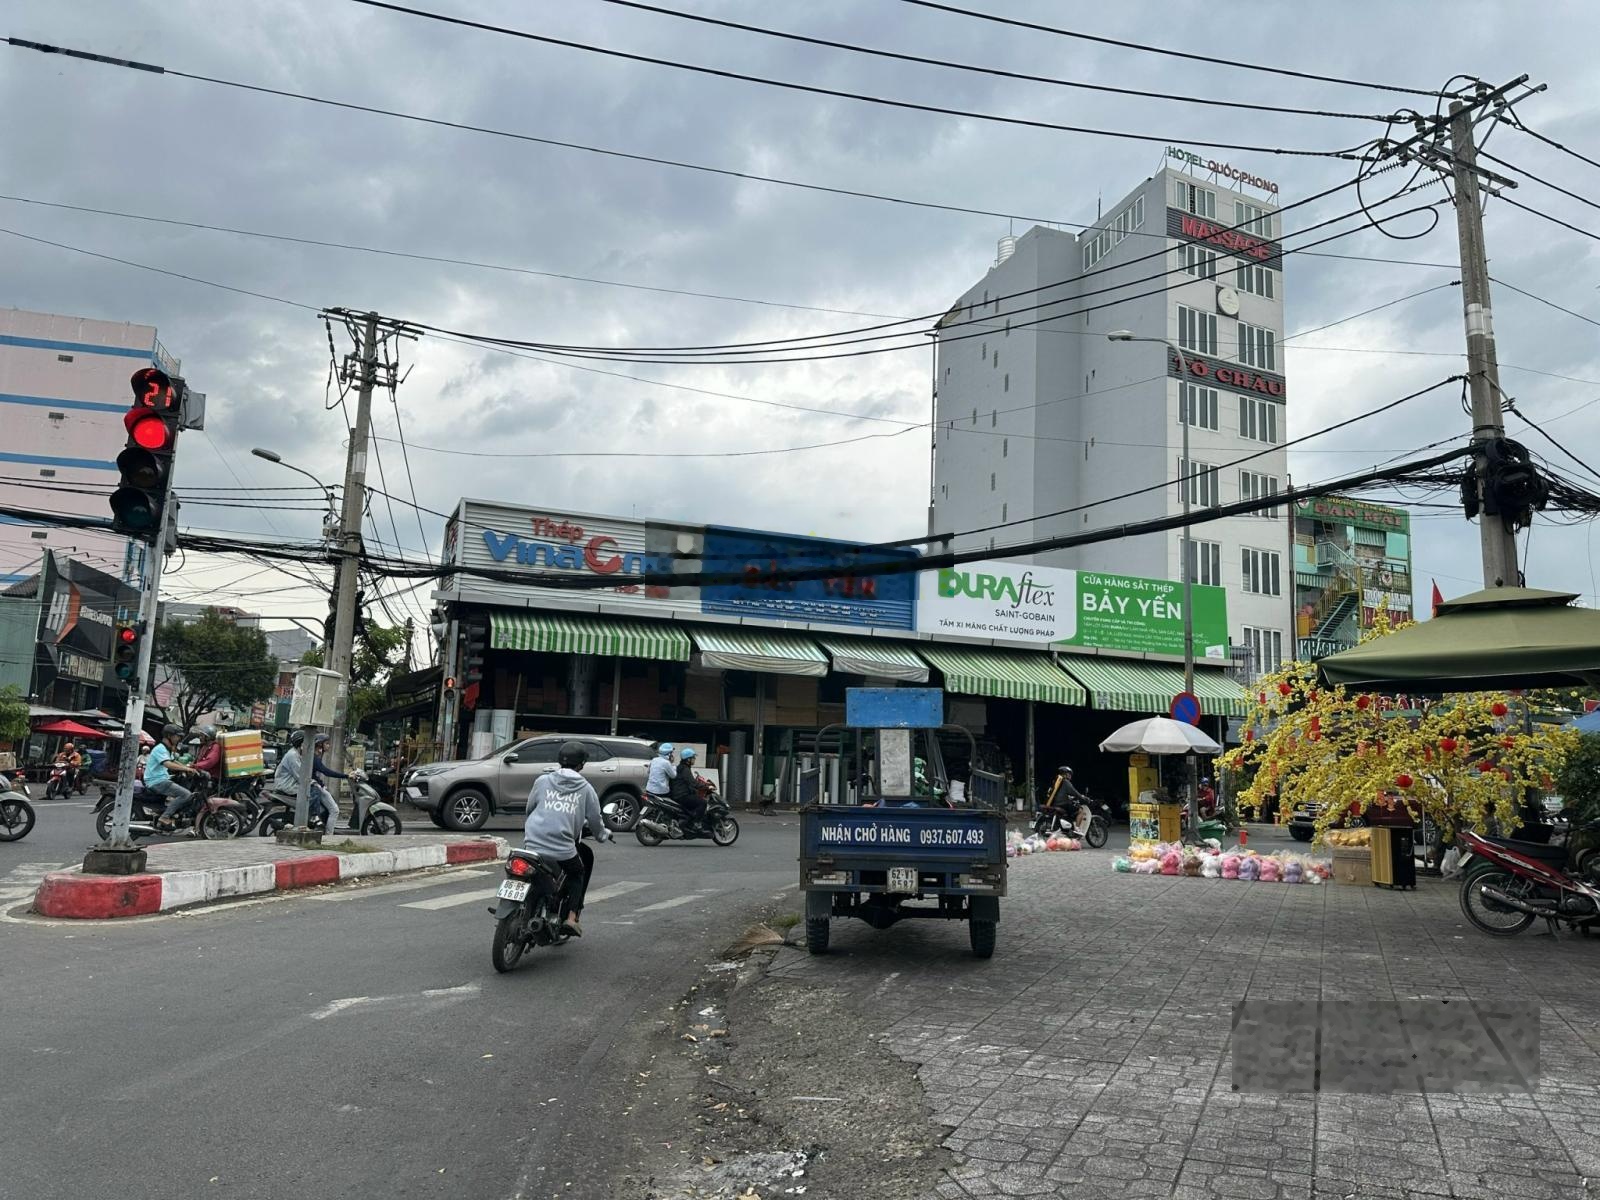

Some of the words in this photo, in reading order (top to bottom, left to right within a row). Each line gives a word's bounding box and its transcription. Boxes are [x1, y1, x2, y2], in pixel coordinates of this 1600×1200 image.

[1168, 145, 1206, 168] HOTEL
[1240, 170, 1279, 194] PHONG
[1181, 215, 1269, 260] MASSAGE
[144, 380, 173, 408] 21
[531, 515, 585, 544] Thép
[1104, 577, 1130, 589] HÀNG
[1152, 582, 1174, 593] THÉP
[995, 608, 1056, 623] SAINT-GOBAIN
[1082, 588, 1130, 614] BẢY
[1137, 593, 1182, 620] YẾN
[957, 620, 964, 628] XI
[544, 799, 578, 814] WORK
[546, 789, 582, 803] WORK
[821, 823, 851, 844] NHẬN
[855, 822, 877, 842] CHỞ
[881, 824, 911, 843] HÀNG
[920, 829, 984, 845] 0937.607.493
